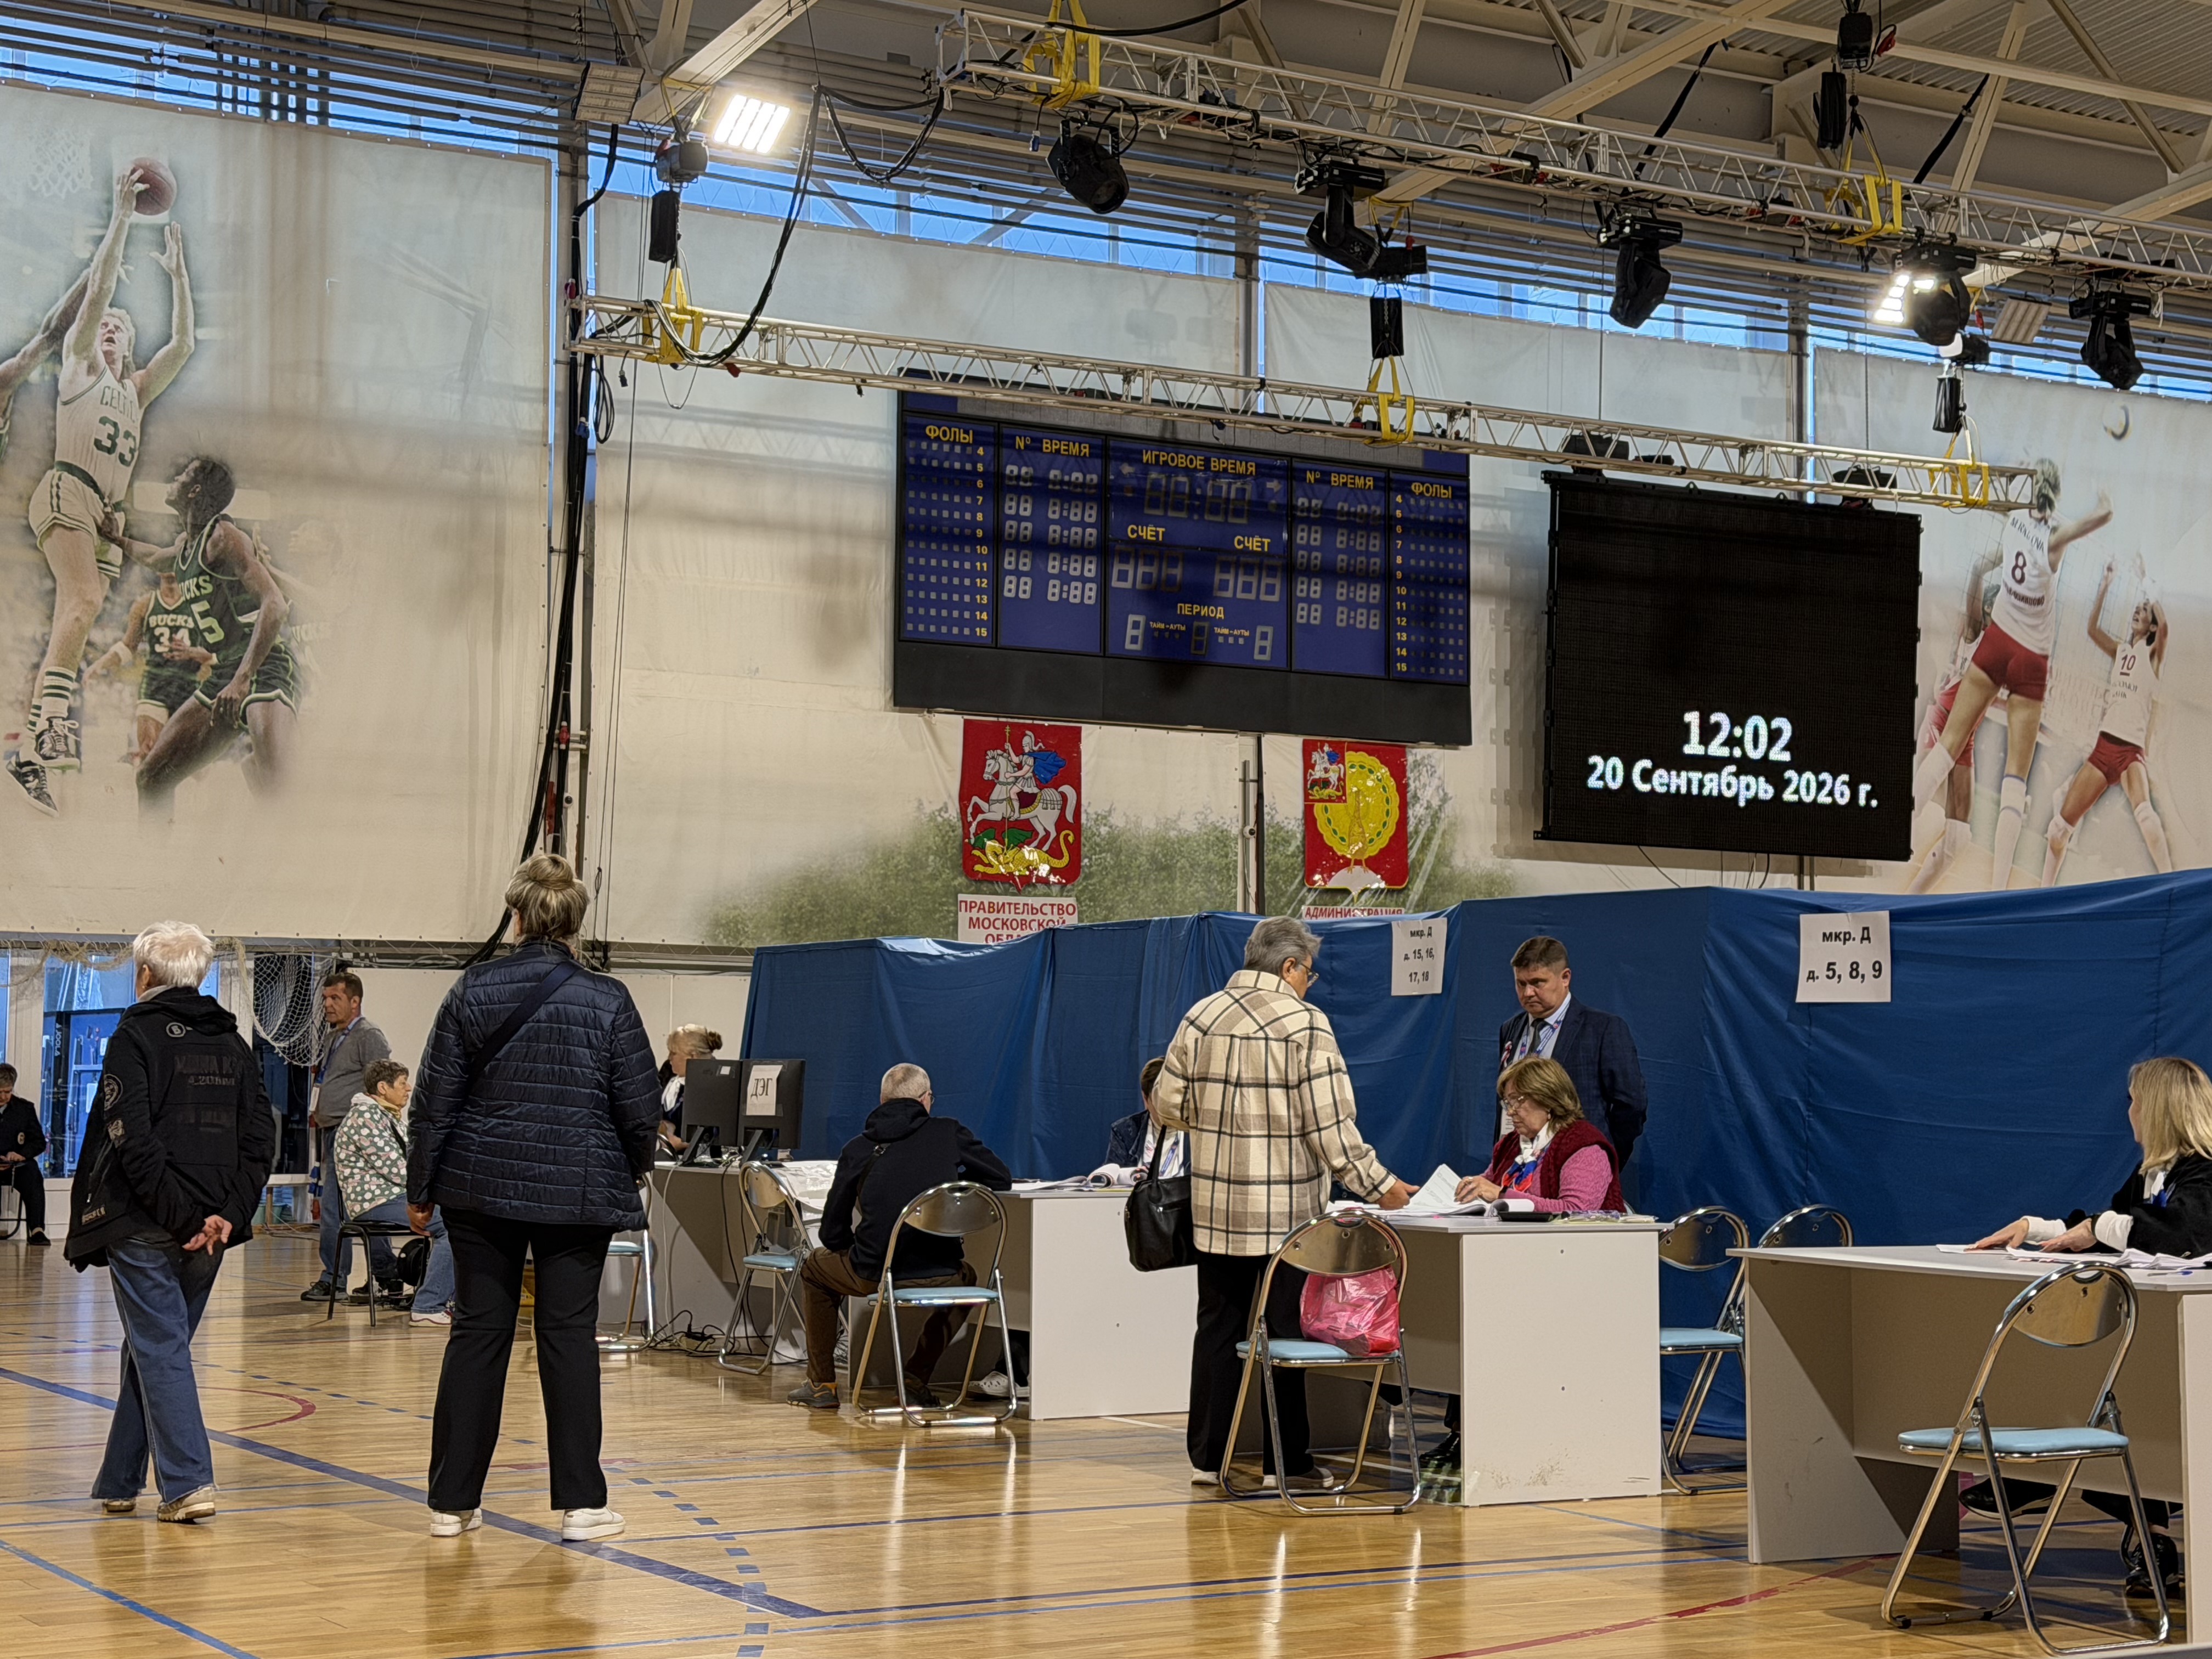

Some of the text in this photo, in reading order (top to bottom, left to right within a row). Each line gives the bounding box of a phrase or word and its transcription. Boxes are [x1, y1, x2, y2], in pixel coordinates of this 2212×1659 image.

[926, 425, 973, 443] ФОЛЫ
[94, 416, 137, 467] 33
[1042, 438, 1090, 456] ВРЕМЯ
[977, 447, 984, 455] 4
[977, 463, 984, 472] 5
[1143, 449, 1256, 475] ИГРОВОЕ ВРЕМЯ
[976, 479, 984, 488] 6
[1331, 472, 1374, 489] ВРЕМЯ
[1411, 482, 1452, 498] ФОЛЫ
[977, 496, 983, 505] 7
[976, 512, 984, 521] 8
[1395, 510, 1402, 518] 5
[975, 529, 984, 538] 9
[1127, 524, 1165, 541] СЧЁТ
[976, 545, 988, 554] 10
[1234, 535, 1271, 552] СЧЁТ
[975, 562, 988, 571] 11
[1396, 556, 1403, 564] 8
[2011, 551, 2027, 585] 8
[1395, 571, 1402, 579] 9
[179, 575, 213, 601] UCKS
[975, 579, 988, 588] 12
[1396, 586, 1407, 595] 10
[975, 595, 988, 604] 13
[1396, 601, 1407, 610] 11
[975, 611, 988, 620] 14
[1177, 603, 1224, 619] ПЕРИОД
[149, 613, 195, 628] BUCKS
[1396, 617, 1407, 625] 12
[975, 628, 988, 636] 15
[1396, 632, 1407, 641] 13
[1396, 647, 1408, 656] 14
[1396, 663, 1407, 671] 15
[2121, 654, 2136, 670] 10
[1683, 710, 1792, 762] 12:02
[1587, 754, 1878, 808] 20 Сентябрь 2026 г.
[958, 900, 1076, 916] ПРАВИТЕЛЬСТВО
[1410, 926, 1432, 939] мкр. Д
[1822, 926, 1871, 945] мкр. Д
[1413, 949, 1423, 961] 15,
[1426, 947, 1435, 960] 16,
[1408, 971, 1429, 984] 17, 18
[1806, 960, 1882, 984] д. 5, 8, 9
[750, 1077, 773, 1101] ДЭГ
